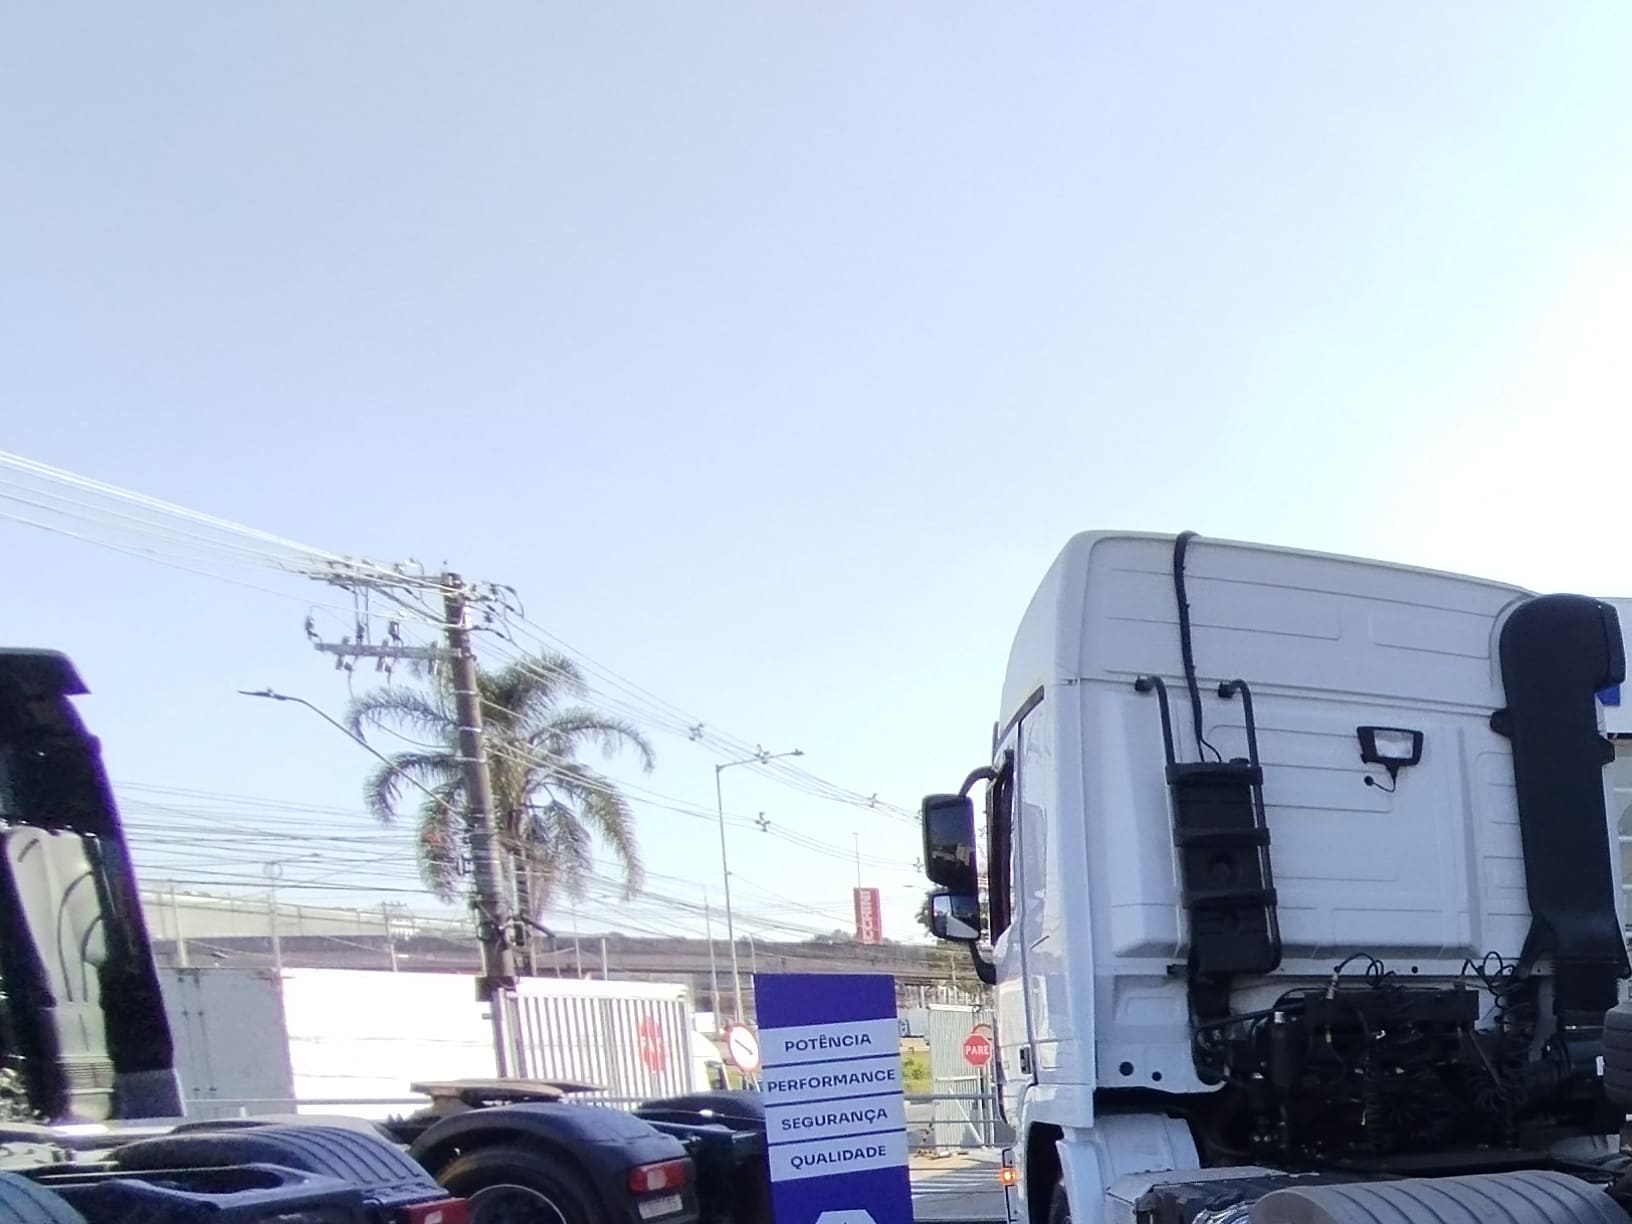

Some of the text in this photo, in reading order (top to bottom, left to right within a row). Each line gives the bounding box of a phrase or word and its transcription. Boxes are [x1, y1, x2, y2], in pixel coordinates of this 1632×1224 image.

[785, 1033, 872, 1052] POTÊNCIA
[965, 1045, 990, 1055] PARE
[767, 1068, 896, 1094] PERFORMANCE
[781, 1108, 888, 1131] SEGURANÇA
[790, 1145, 887, 1169] QUALIDADE
